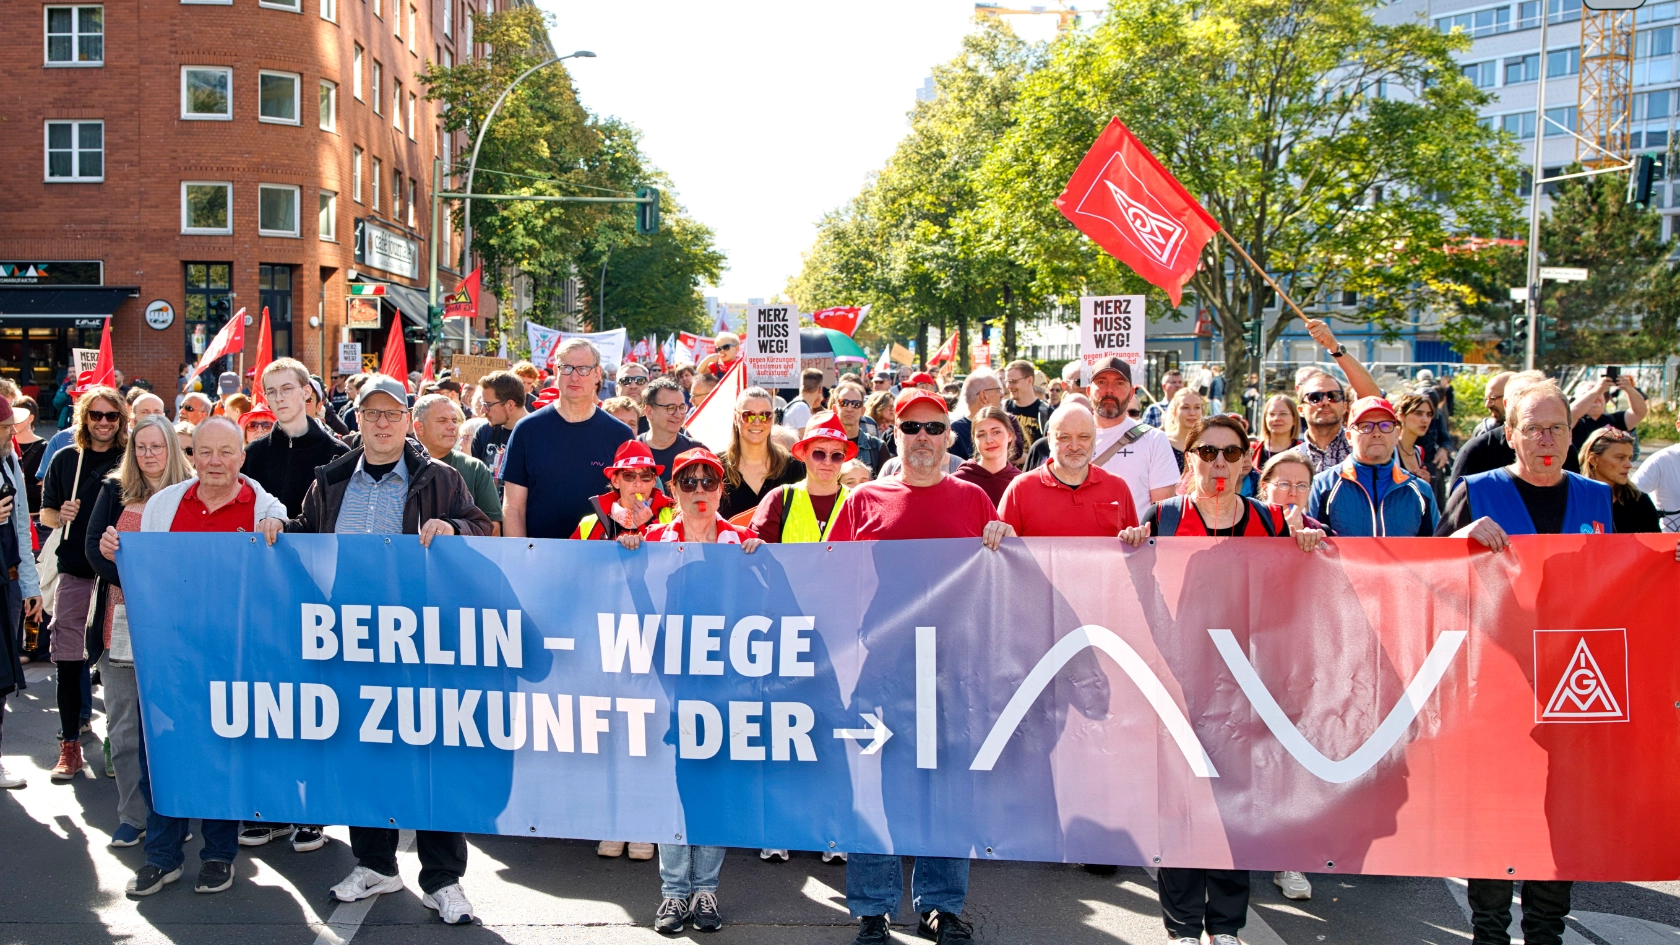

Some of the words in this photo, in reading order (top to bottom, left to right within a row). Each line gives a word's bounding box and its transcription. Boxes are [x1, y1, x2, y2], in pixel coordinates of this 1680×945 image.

[375, 231, 387, 252] café
[1094, 299, 1131, 315] MERZ
[758, 308, 788, 322] MERZ
[758, 323, 789, 338] MUSS
[1093, 316, 1131, 332] MUSS
[758, 339, 788, 353] WEG!
[1094, 333, 1130, 348] WEG!
[454, 355, 472, 365] GELD
[767, 356, 797, 364] Kürzungen,
[801, 357, 830, 369] OPPT
[1084, 353, 1102, 361] gegen
[81, 362, 97, 371] MUS
[757, 369, 789, 377] Aufrüstung!
[301, 602, 523, 668] BERLIN
[597, 612, 816, 678] WIEGE
[210, 680, 340, 740] UND
[359, 685, 656, 757] ZUKUNFT
[678, 699, 818, 762] DER
